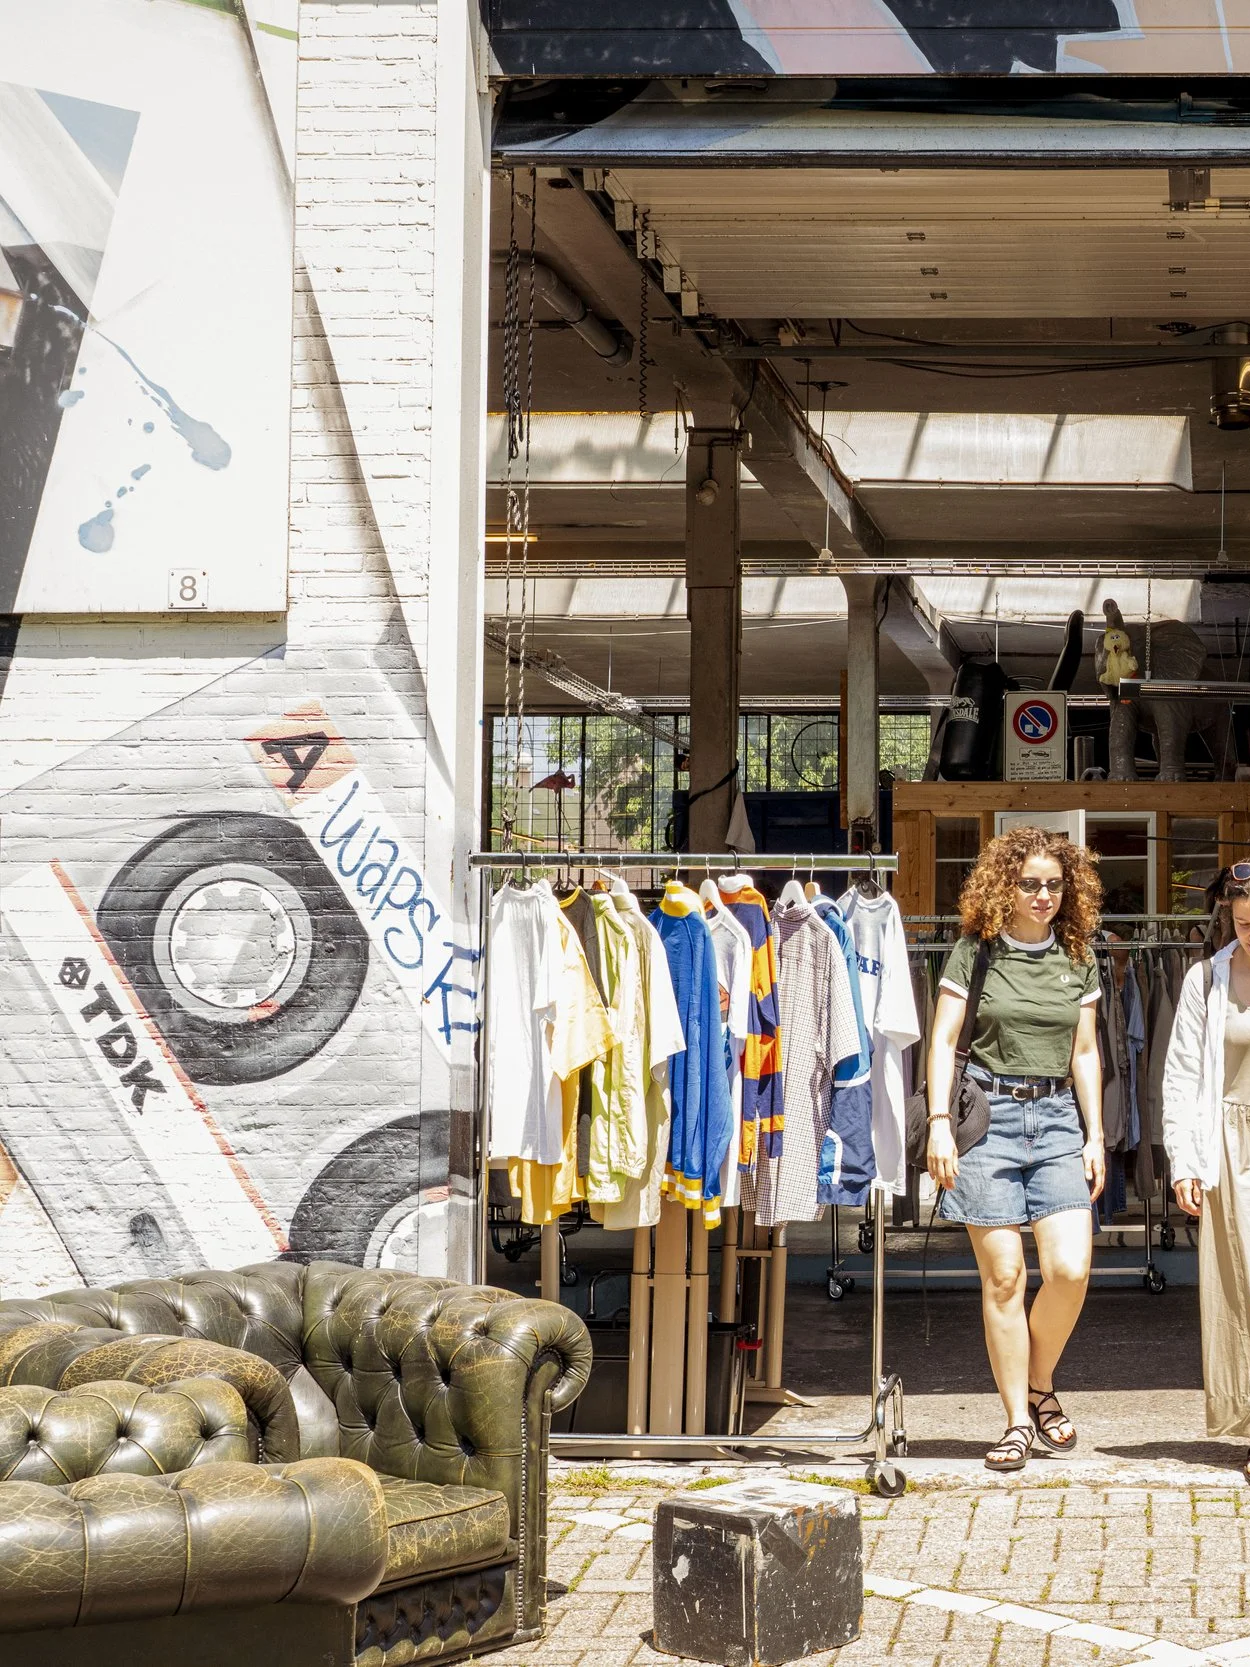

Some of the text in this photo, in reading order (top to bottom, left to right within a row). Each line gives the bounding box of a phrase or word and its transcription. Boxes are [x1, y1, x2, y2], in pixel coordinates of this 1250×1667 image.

[179, 575, 197, 602] 8
[260, 730, 331, 795] A
[79, 981, 168, 1116] TDK
